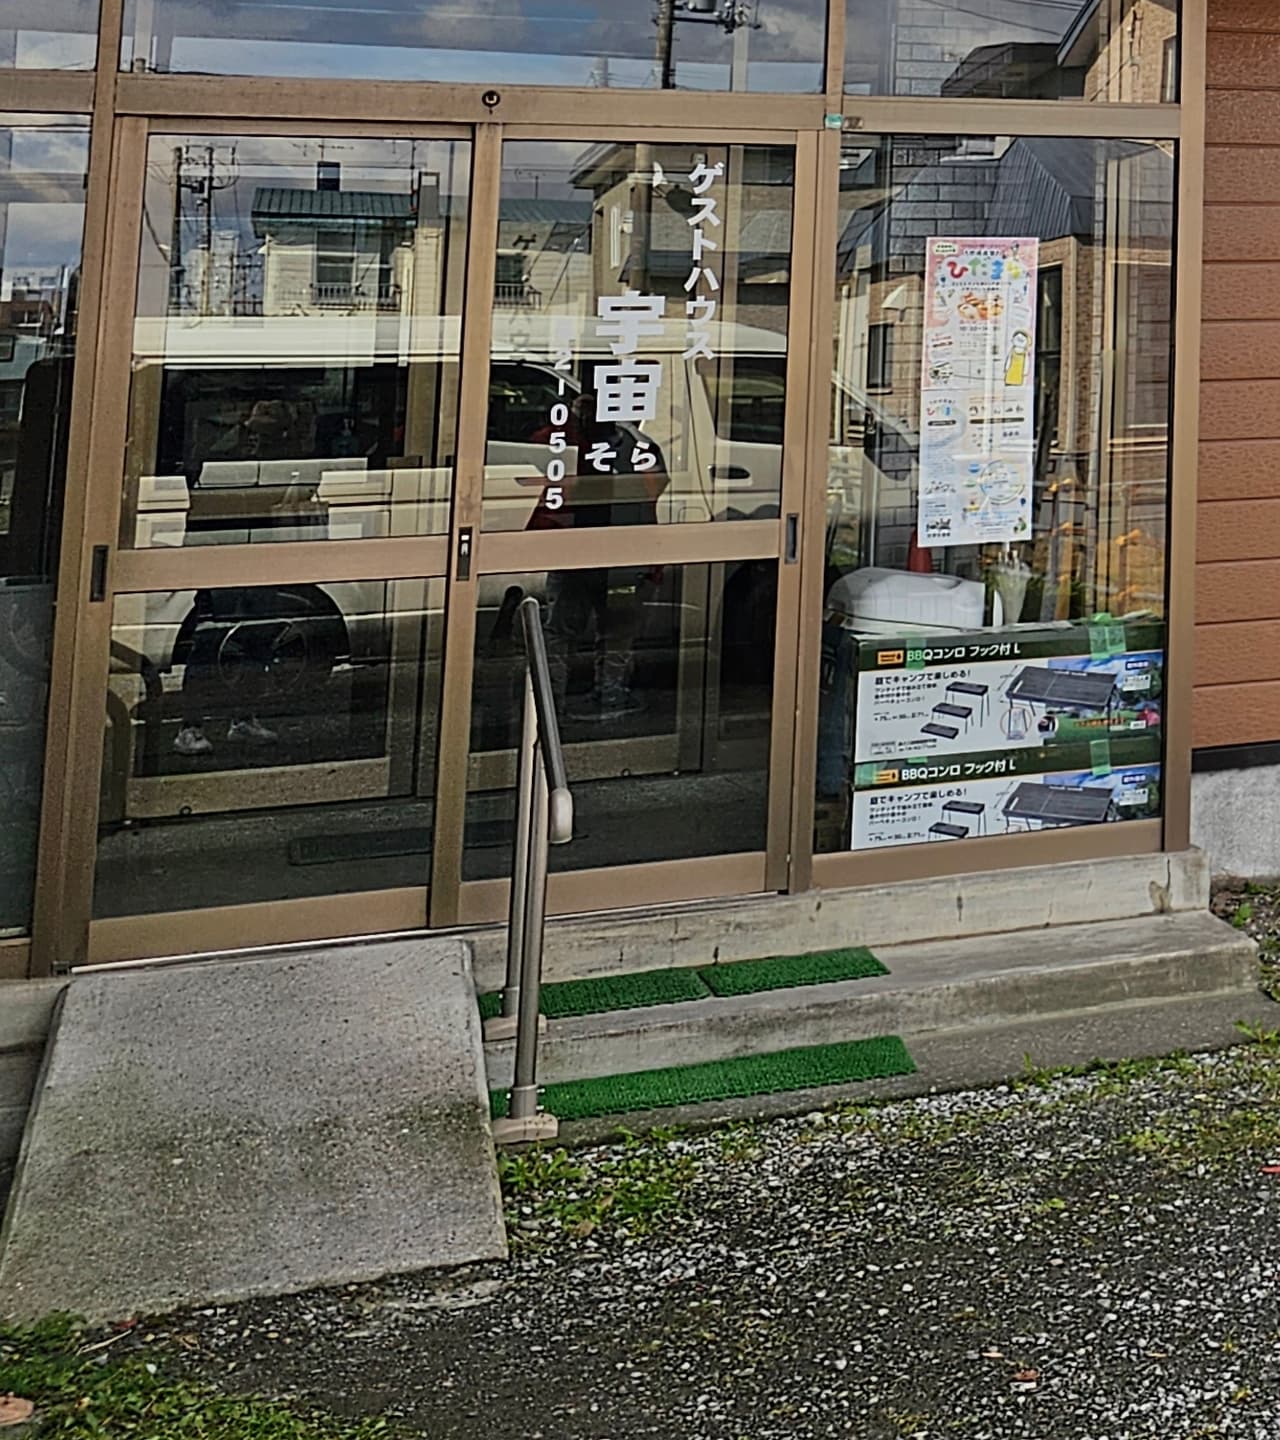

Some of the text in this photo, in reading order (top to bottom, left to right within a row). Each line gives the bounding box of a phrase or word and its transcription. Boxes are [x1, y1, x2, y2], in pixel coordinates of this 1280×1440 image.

[682, 162, 725, 360] ゲストハウス
[594, 291, 666, 422] 宇宙
[585, 441, 657, 472] そら
[907, 646, 966, 661] BBQコンロ
[969, 642, 1011, 657] フック付
[1014, 642, 1021, 654] L
[902, 764, 961, 781] BBQコンロ
[964, 759, 1006, 775] フック付
[1009, 759, 1017, 771] L
